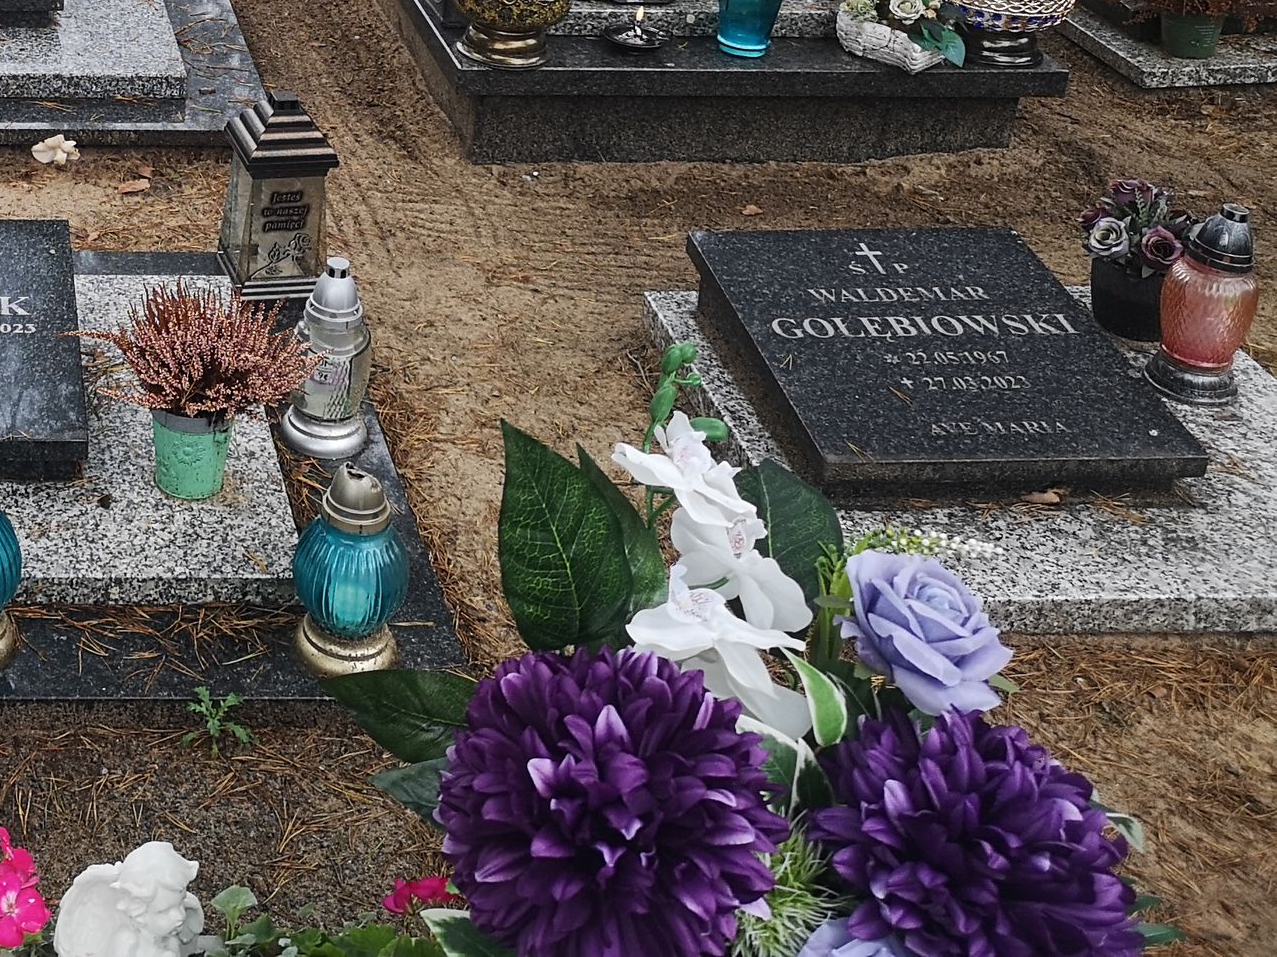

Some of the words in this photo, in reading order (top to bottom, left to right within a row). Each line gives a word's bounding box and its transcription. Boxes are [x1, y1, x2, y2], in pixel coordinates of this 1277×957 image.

[271, 192, 302, 203] Jesteś
[276, 205, 308, 217] naszej
[265, 220, 303, 233] pamięci
[806, 286, 991, 304] WALDEMAR
[771, 313, 1081, 343] GOŁĘBIOWSKI
[930, 422, 977, 437] AVE
[981, 420, 1072, 436] MARIA
